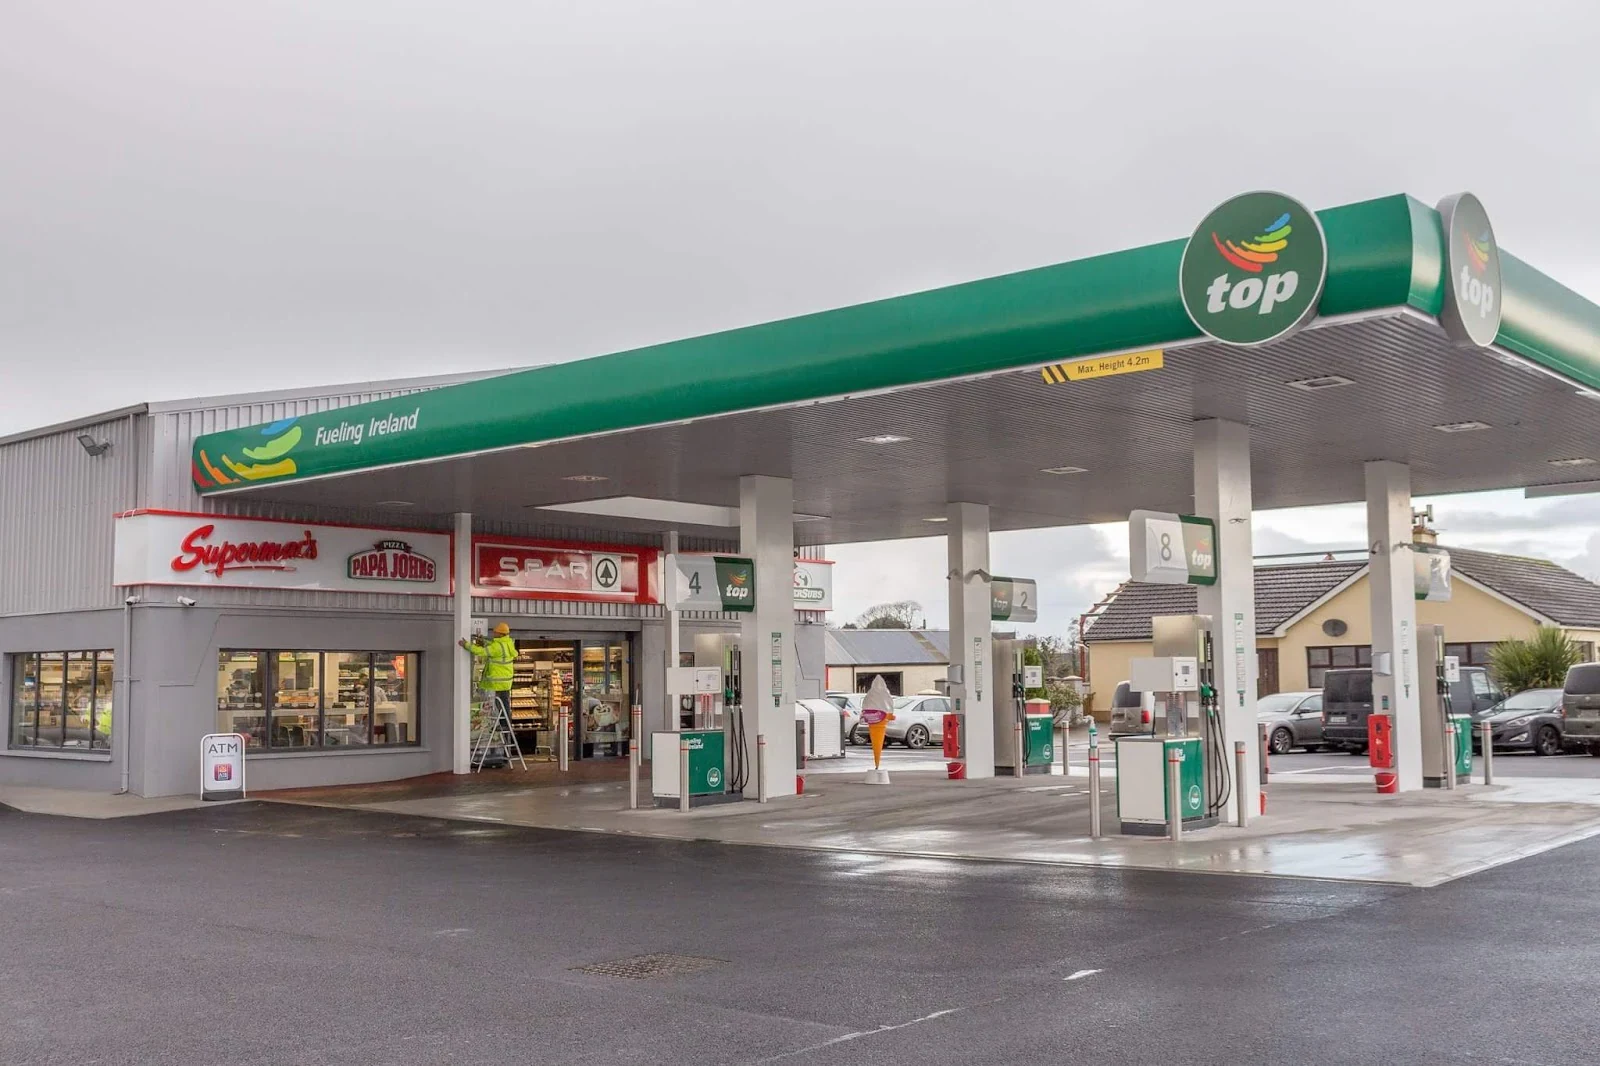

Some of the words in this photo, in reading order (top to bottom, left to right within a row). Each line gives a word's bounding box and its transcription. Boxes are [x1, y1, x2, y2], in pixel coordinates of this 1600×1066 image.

[1206, 270, 1299, 315] top
[1460, 264, 1494, 319] top
[1077, 365, 1096, 375] Max.
[1099, 360, 1125, 372] Height
[1127, 356, 1150, 367] 4.2m
[315, 421, 364, 446] Fueling
[368, 407, 420, 437] Ireland
[383, 541, 405, 550] PIZZA
[1161, 532, 1172, 562] 8
[352, 552, 389, 578] PAPA
[390, 552, 434, 580] JOHNS
[499, 556, 589, 581] SPAR
[1191, 549, 1212, 570] top
[688, 571, 702, 595] 4
[726, 584, 748, 600] top
[1020, 591, 1028, 609] 2
[208, 743, 238, 754] ATM
